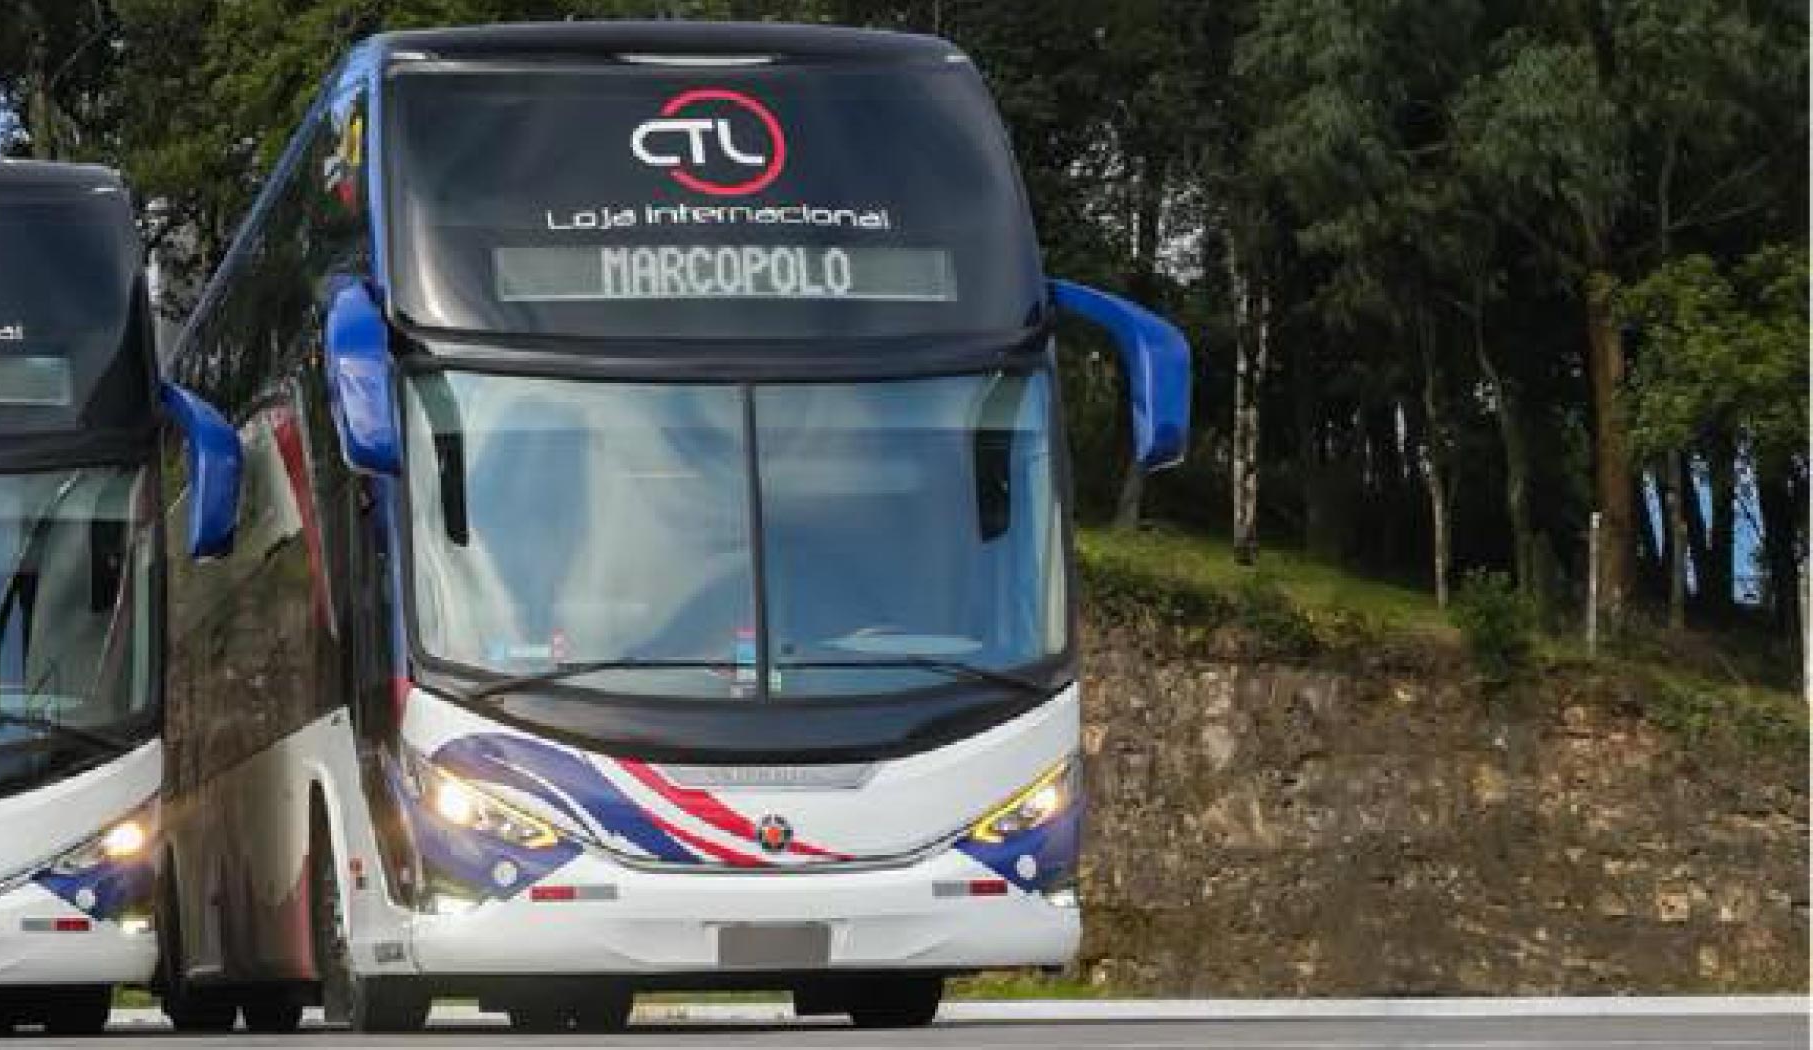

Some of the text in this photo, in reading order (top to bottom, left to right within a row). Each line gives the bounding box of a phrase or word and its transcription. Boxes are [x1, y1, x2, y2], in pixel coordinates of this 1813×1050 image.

[630, 119, 765, 166] CTL
[547, 207, 636, 230] Loja
[601, 246, 852, 297] MARCOPOLO
